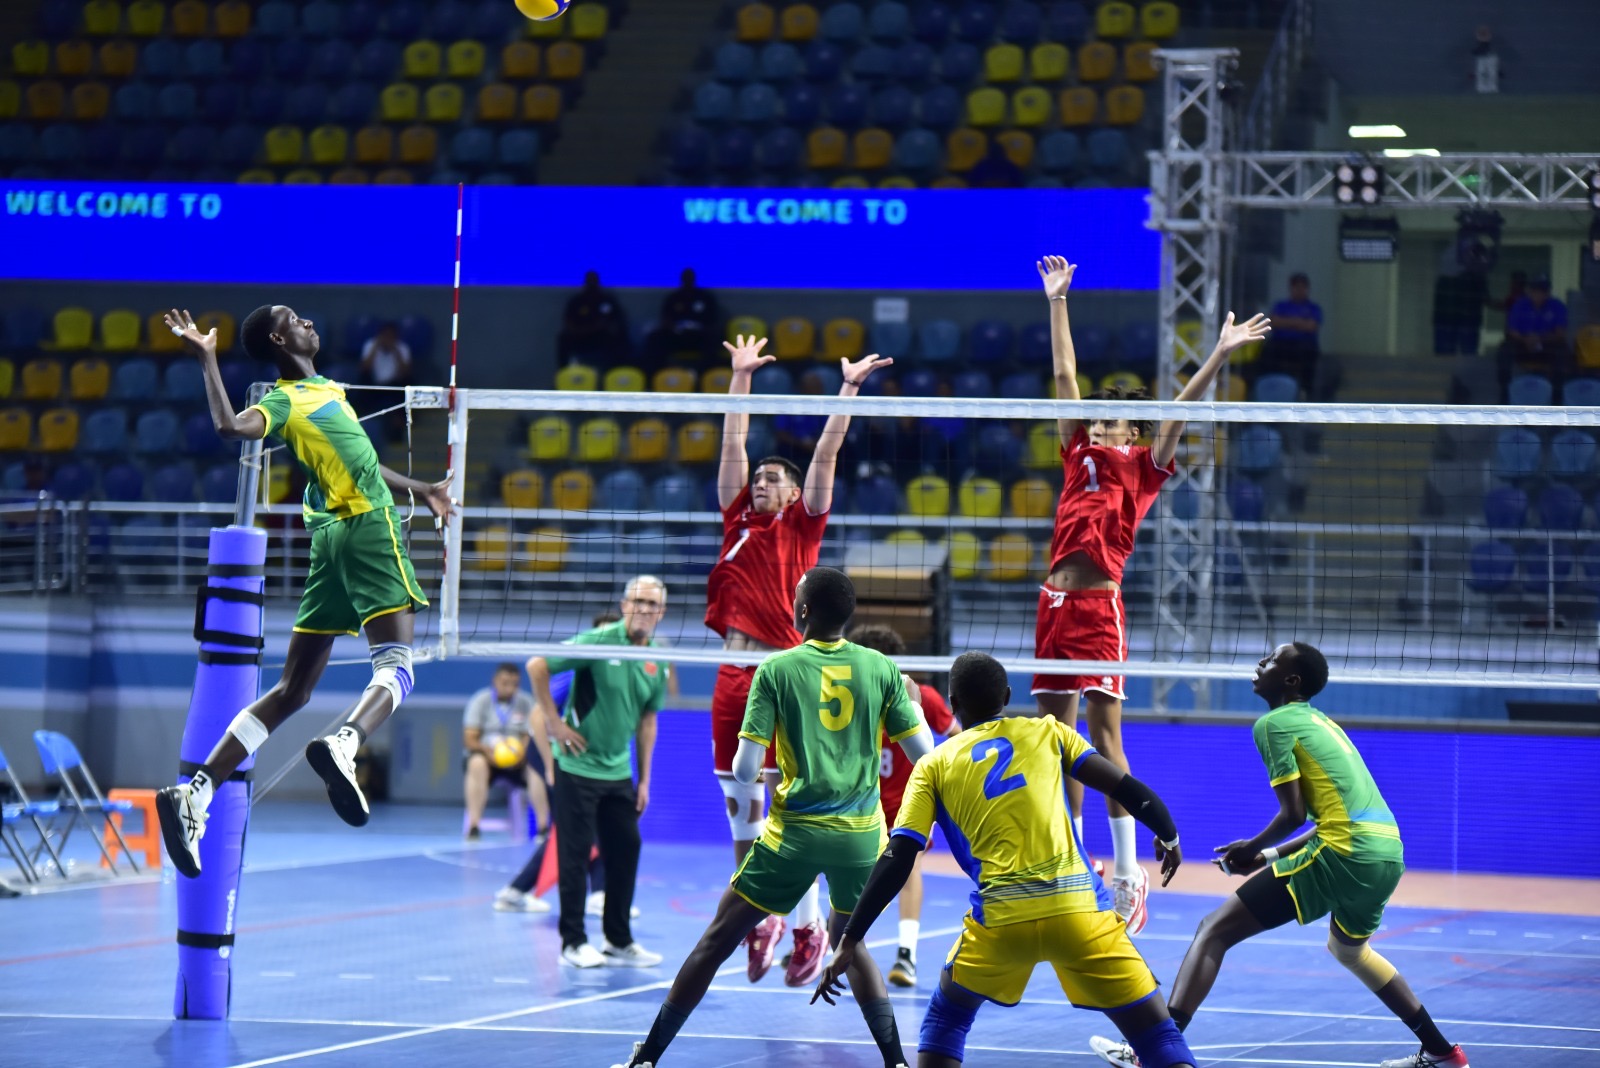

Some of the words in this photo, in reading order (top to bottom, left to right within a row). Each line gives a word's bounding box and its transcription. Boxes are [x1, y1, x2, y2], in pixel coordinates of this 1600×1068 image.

[6, 190, 168, 219] WELCOME
[179, 192, 222, 220] TO
[684, 198, 852, 224] WELCOME
[863, 199, 907, 225] TO
[1083, 456, 1100, 492] 1
[818, 665, 855, 732] 5
[971, 736, 1028, 800] 2
